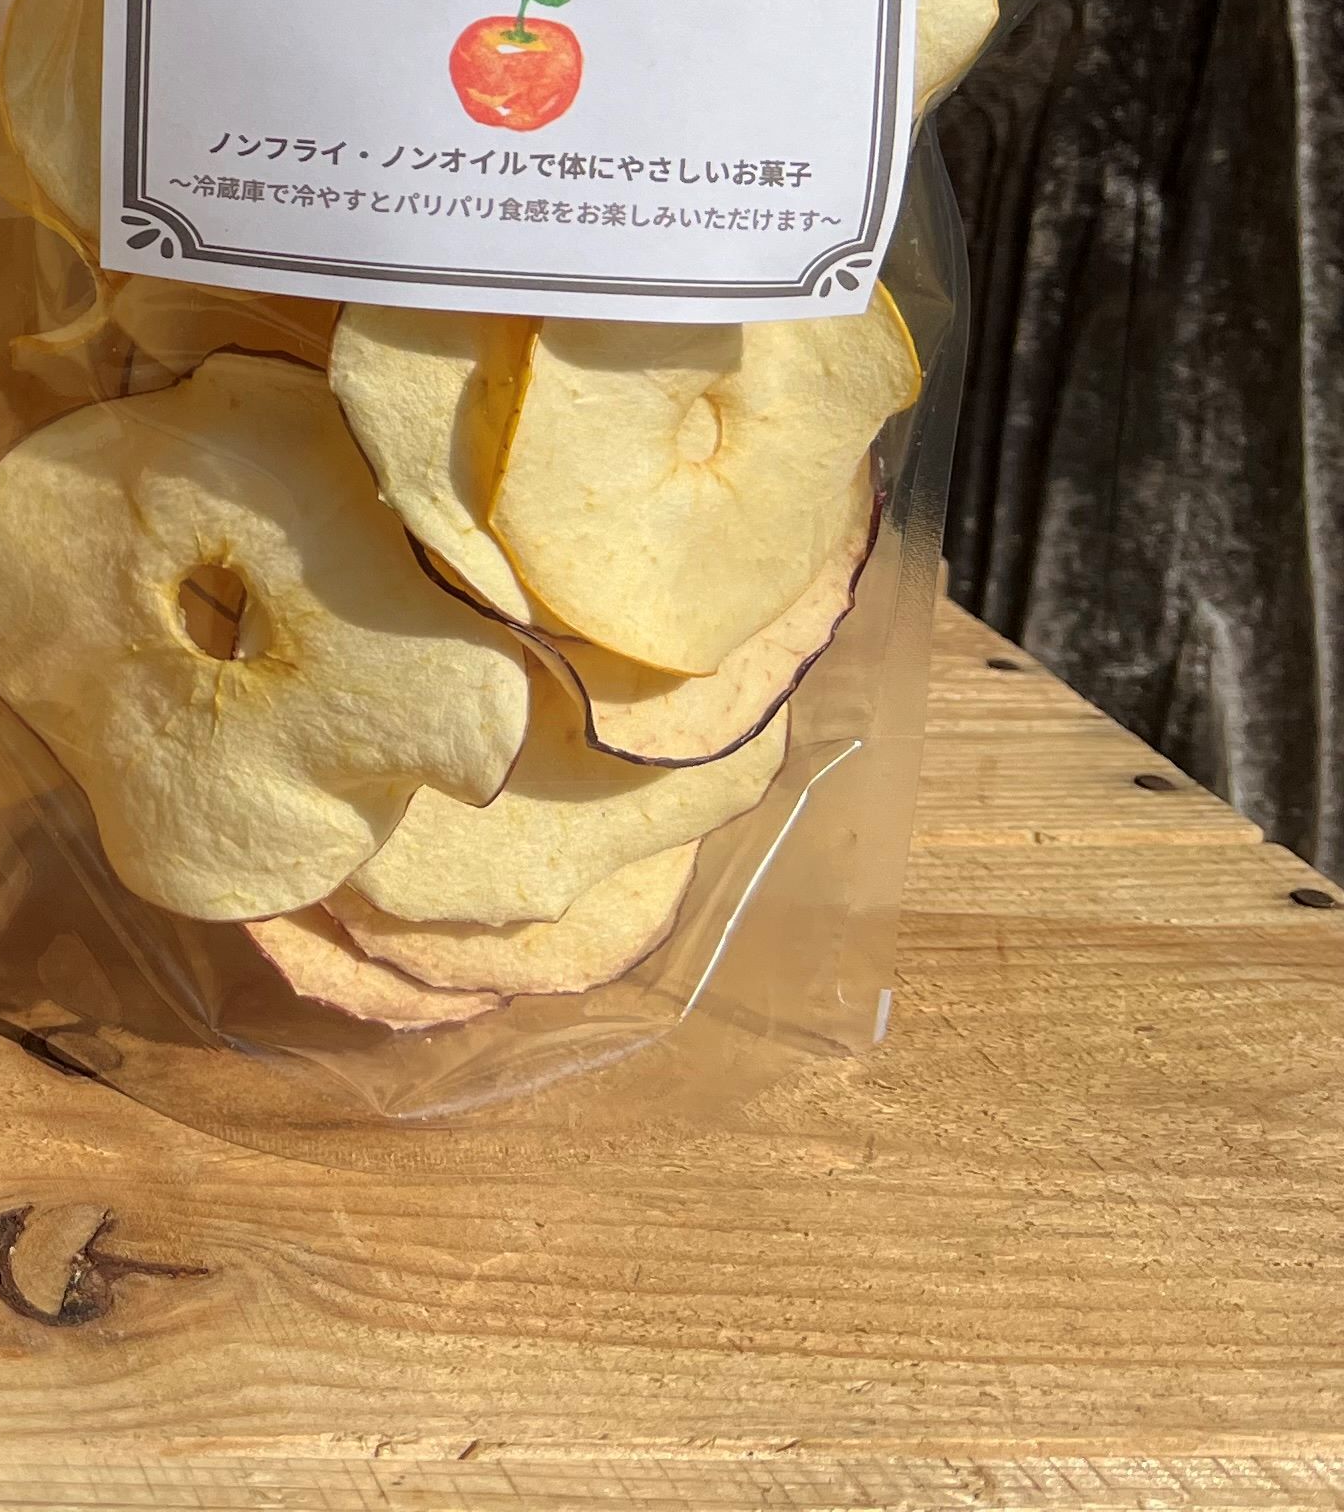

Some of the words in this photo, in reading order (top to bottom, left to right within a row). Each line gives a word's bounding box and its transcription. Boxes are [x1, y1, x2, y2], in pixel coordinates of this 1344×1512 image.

[209, 132, 813, 188] ノンフライ・ノンオイルで体にやさしいお菓子
